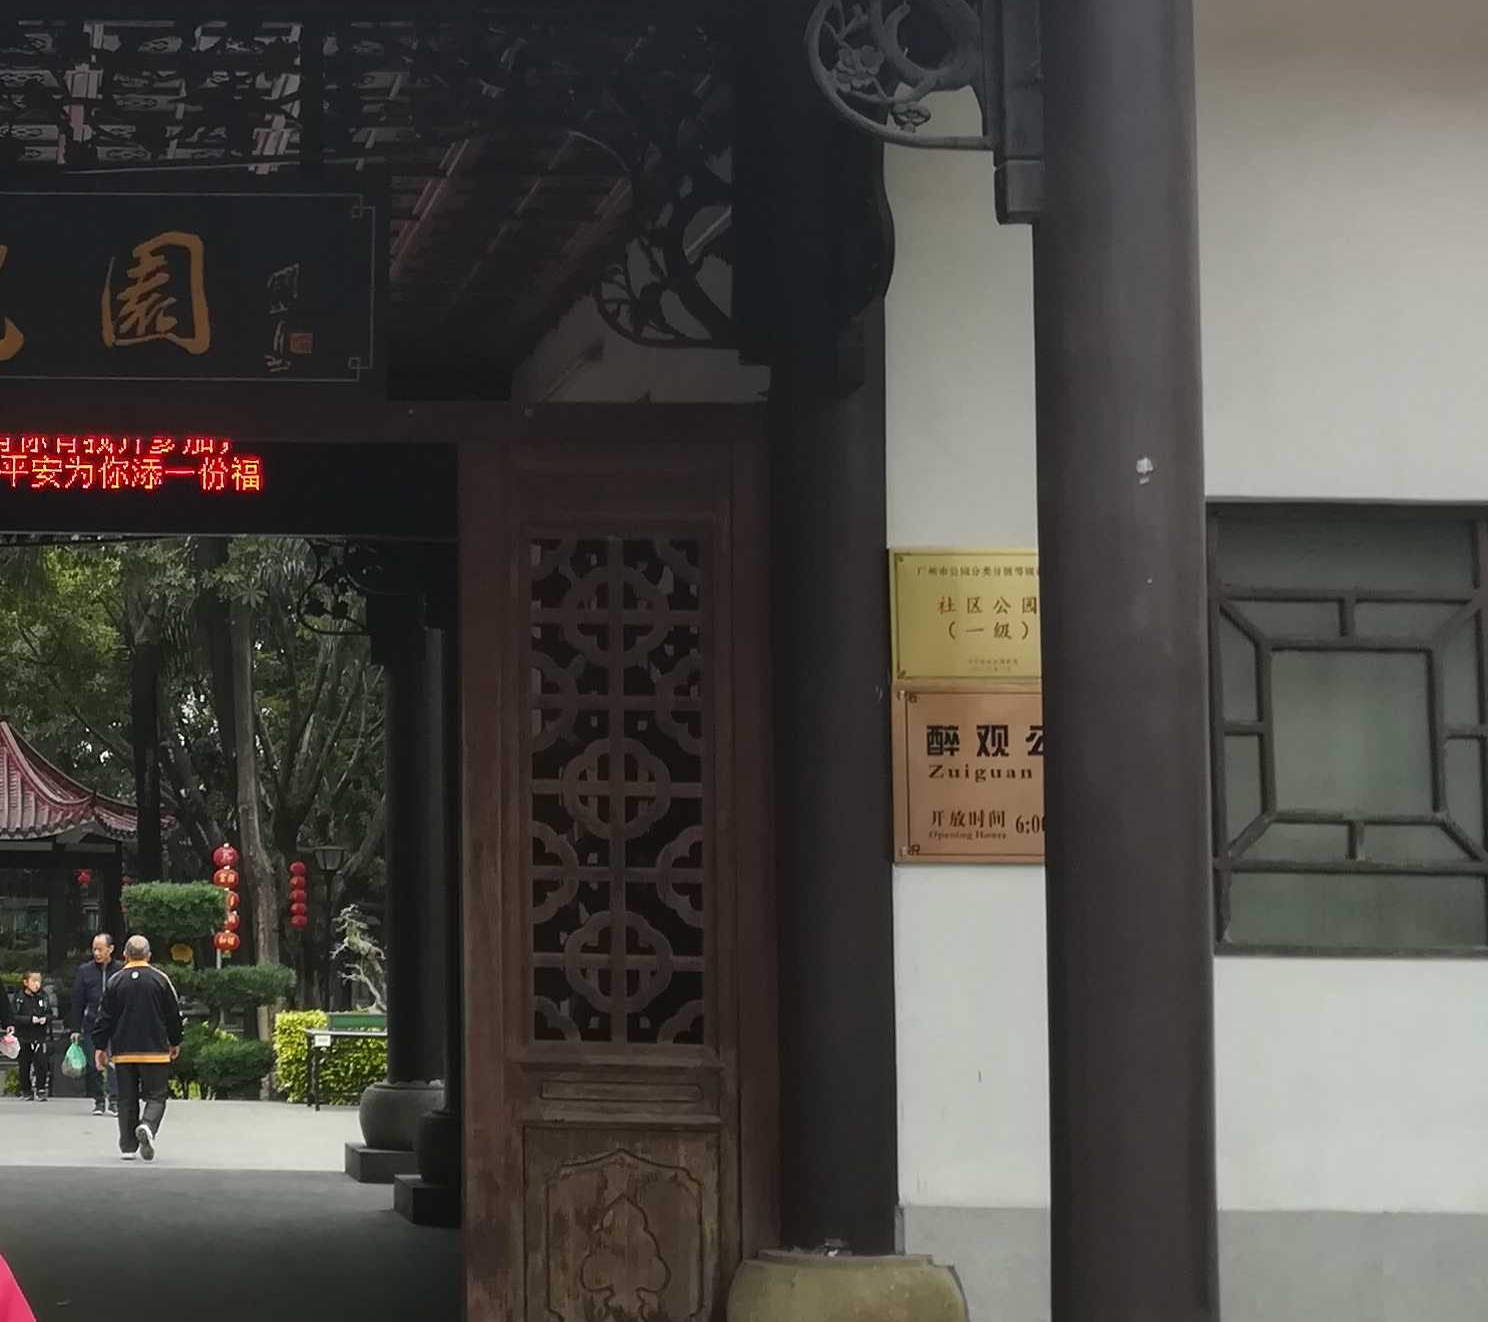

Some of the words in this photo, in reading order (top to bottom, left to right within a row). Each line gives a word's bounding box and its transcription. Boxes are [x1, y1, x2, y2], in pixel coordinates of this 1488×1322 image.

[937, 596, 1037, 614] 社区公园
[928, 763, 1033, 783] Zuiguan
[931, 809, 1006, 828] 开放时间
